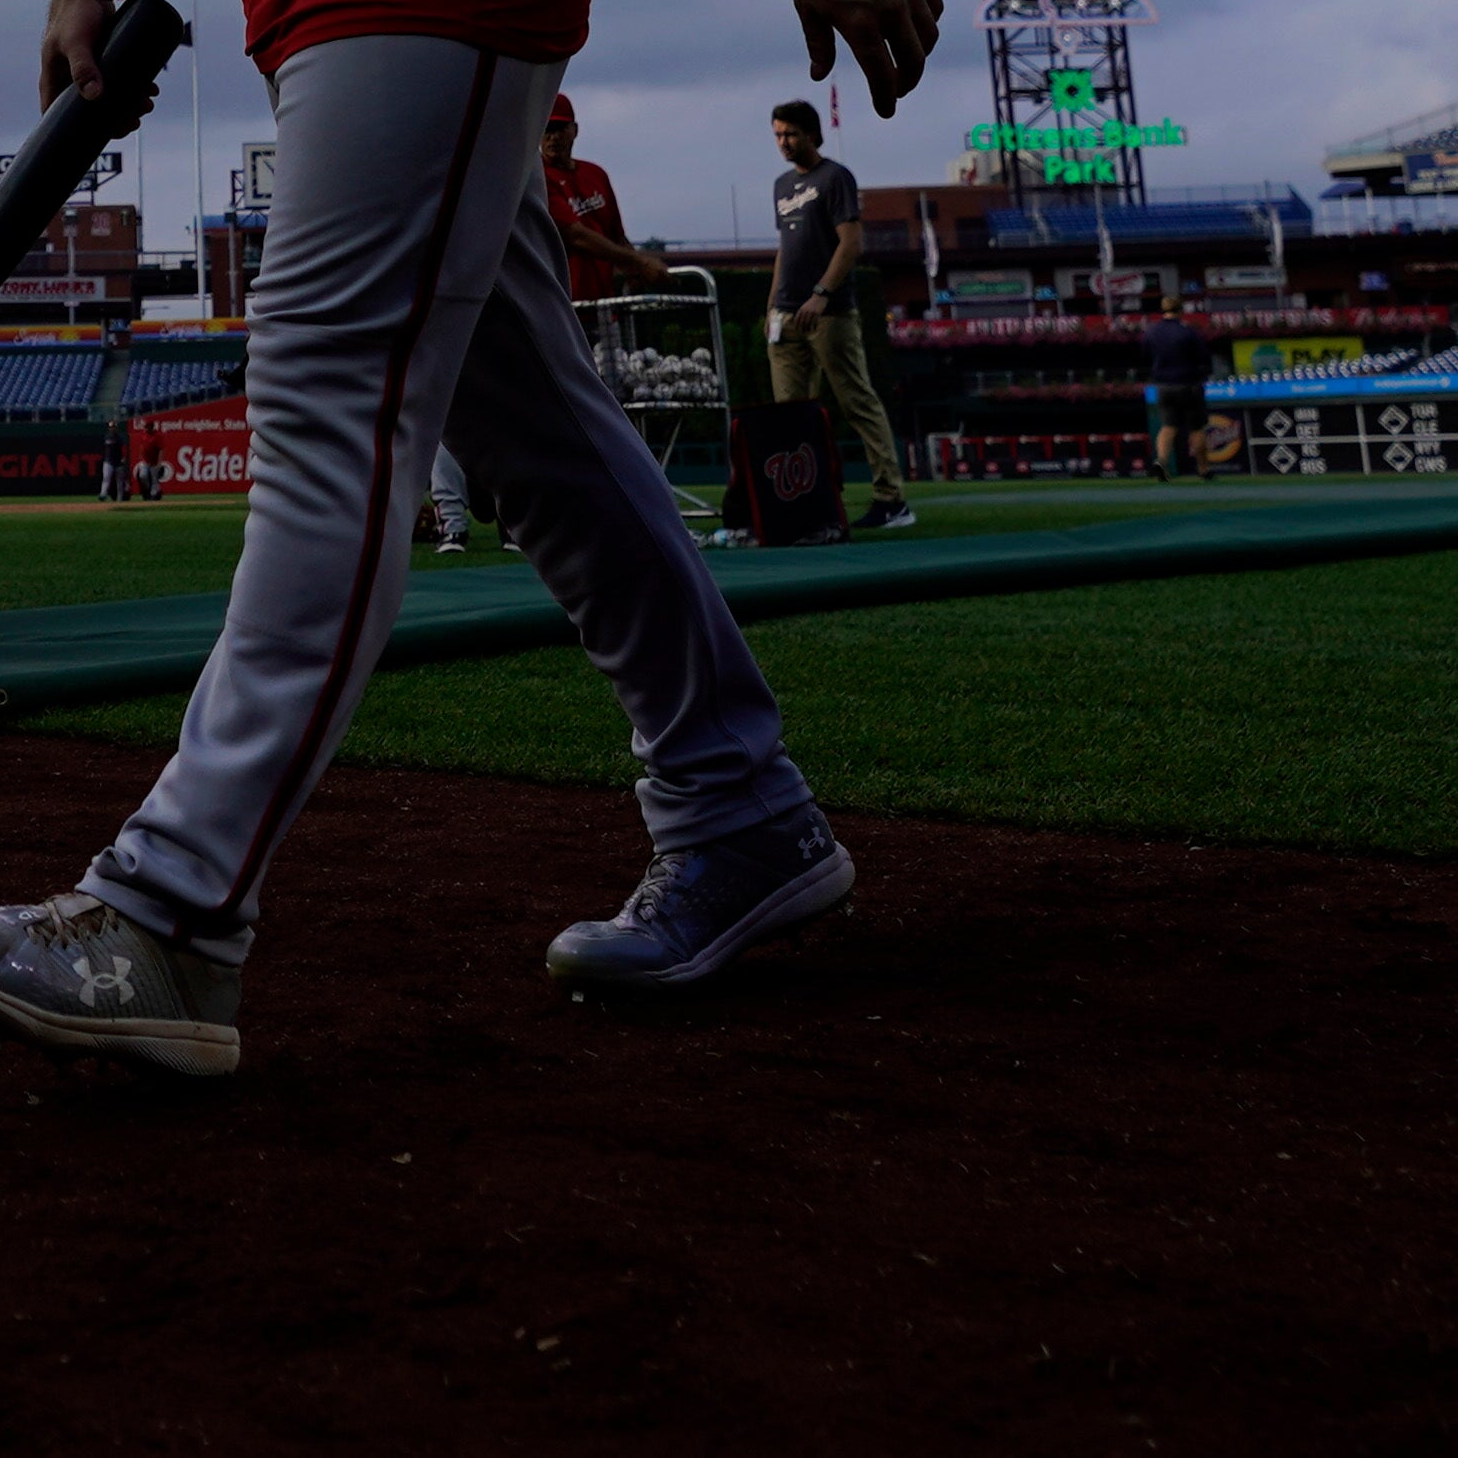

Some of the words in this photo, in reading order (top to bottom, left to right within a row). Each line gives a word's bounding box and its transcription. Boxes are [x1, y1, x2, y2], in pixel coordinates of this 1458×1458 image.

[971, 123, 1098, 152] Citizens
[1101, 117, 1183, 148] Bank
[1044, 153, 1117, 185] Park
